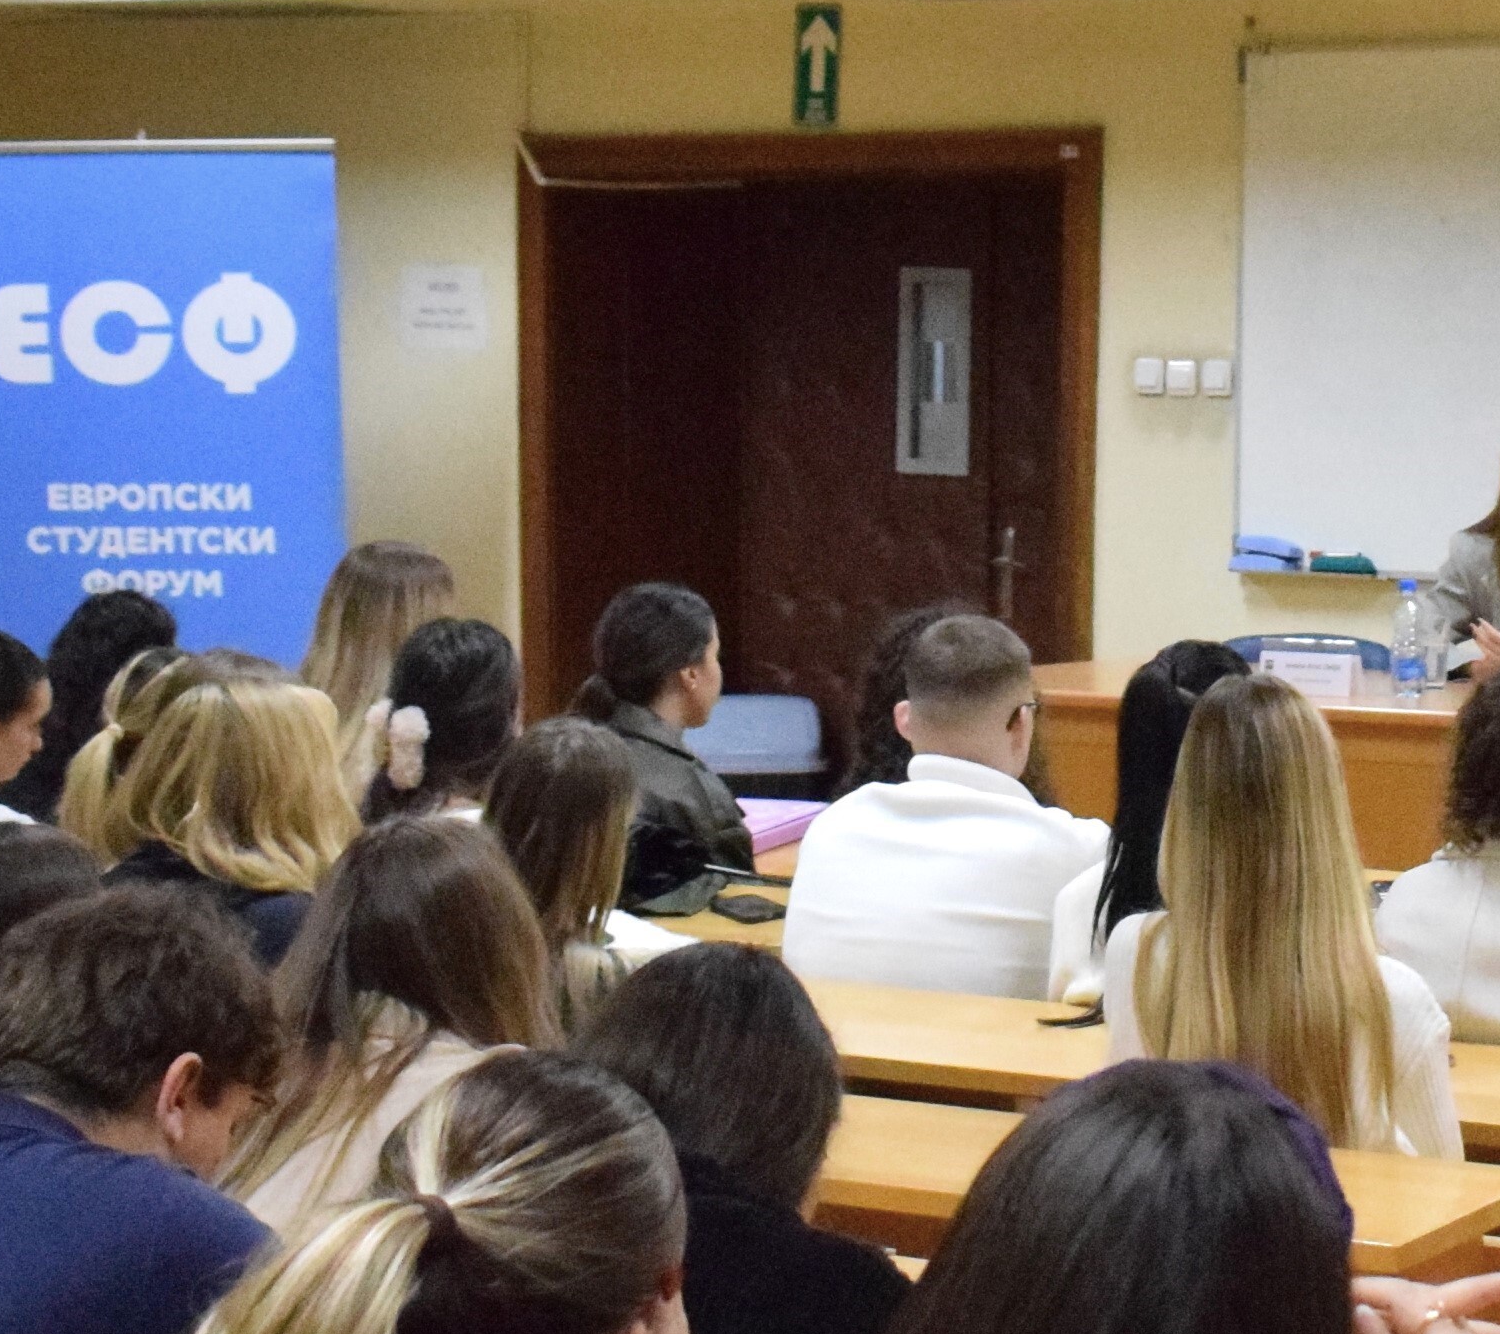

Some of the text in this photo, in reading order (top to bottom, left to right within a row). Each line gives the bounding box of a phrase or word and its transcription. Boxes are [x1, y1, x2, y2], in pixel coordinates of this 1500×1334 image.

[46, 482, 253, 512] ЕВРОПСКИ
[26, 525, 278, 559] СТУДЕНТСКИ
[81, 568, 225, 598] ФОРУМ
